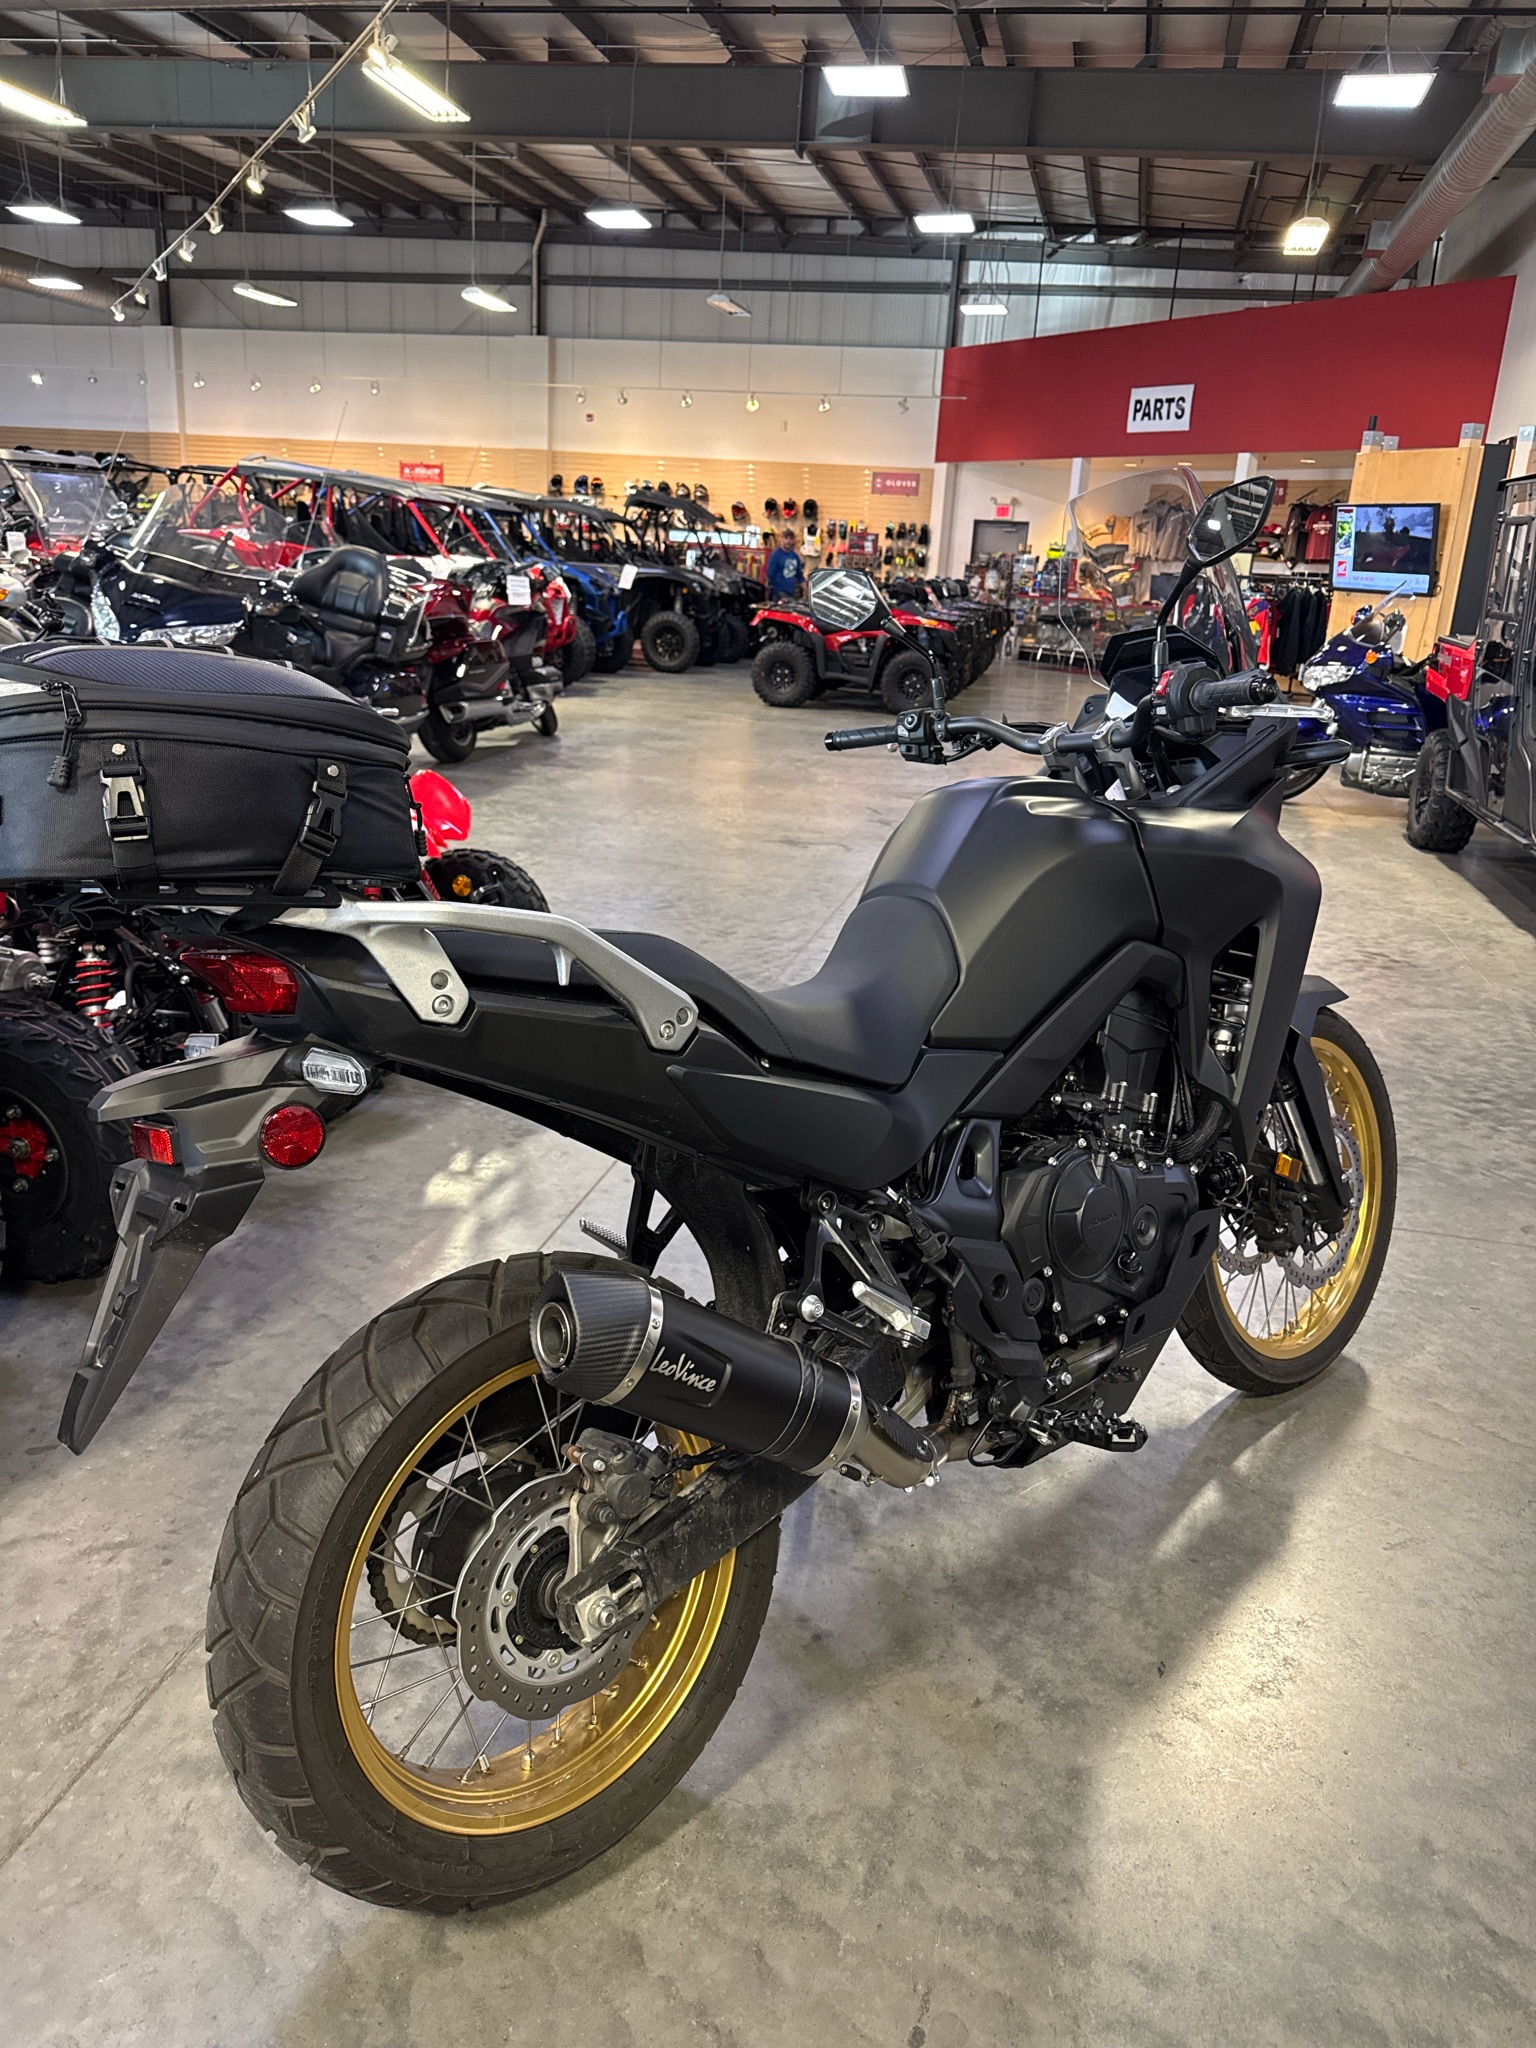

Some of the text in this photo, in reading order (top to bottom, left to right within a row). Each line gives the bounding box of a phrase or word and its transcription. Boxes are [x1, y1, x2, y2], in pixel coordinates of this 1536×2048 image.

[1132, 396, 1186, 421] PARTS
[885, 479, 917, 488] GLOVES
[649, 1345, 717, 1393] LeoVince
